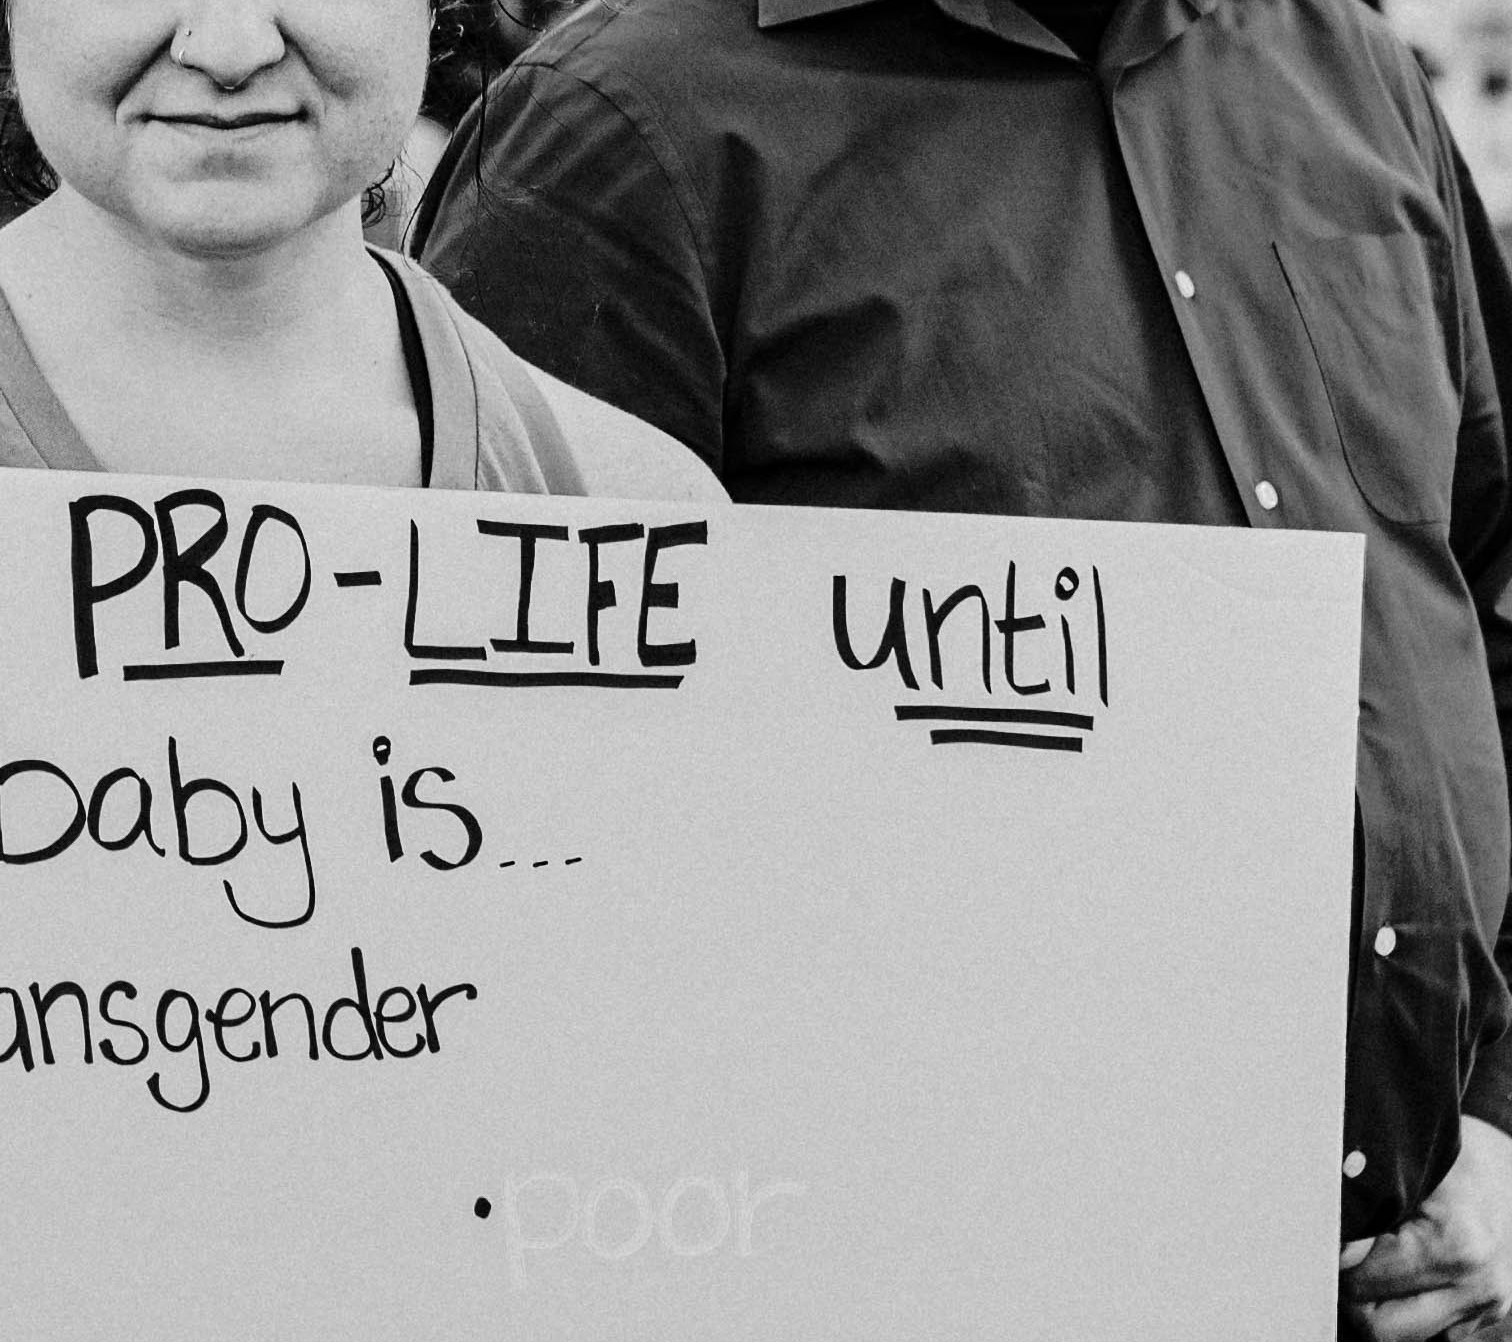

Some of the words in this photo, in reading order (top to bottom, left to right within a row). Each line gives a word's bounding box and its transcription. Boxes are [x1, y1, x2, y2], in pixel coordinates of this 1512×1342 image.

[69, 489, 710, 669] PRO-LIFE
[832, 561, 1110, 709] until
[502, 1167, 810, 1291] poor
